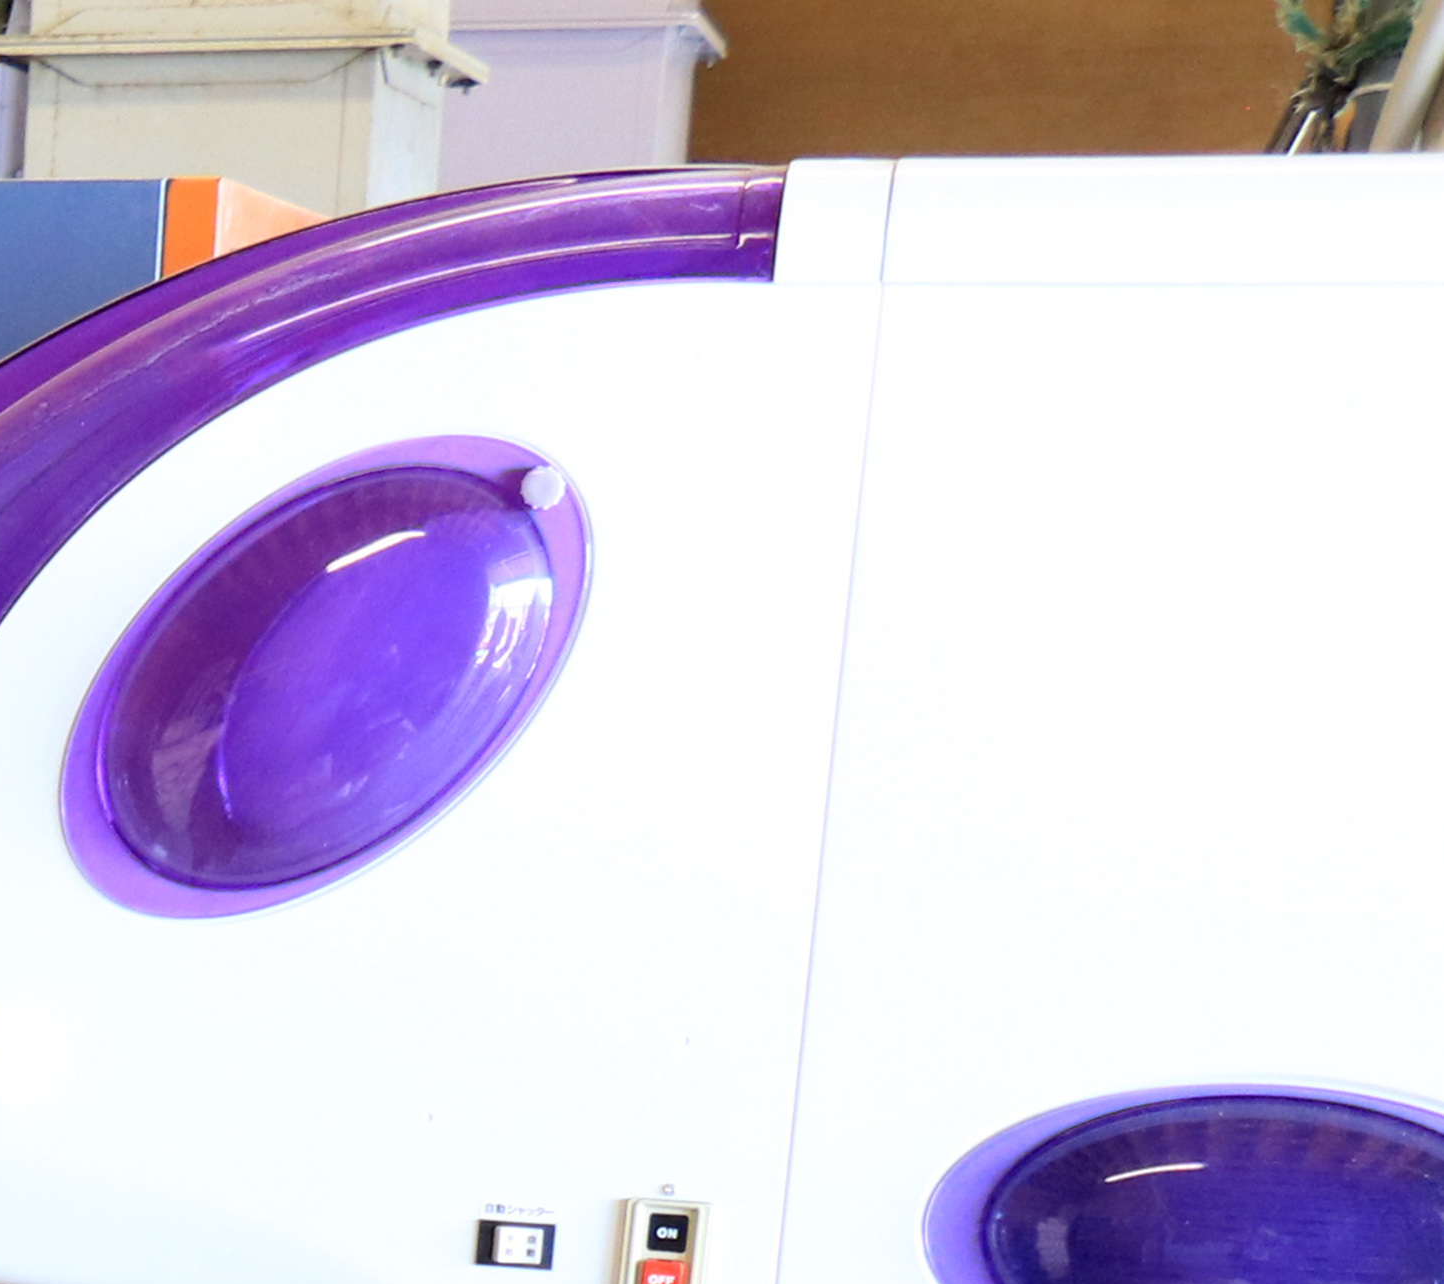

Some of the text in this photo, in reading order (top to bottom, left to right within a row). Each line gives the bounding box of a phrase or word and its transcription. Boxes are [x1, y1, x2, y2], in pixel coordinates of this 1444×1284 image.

[484, 1203, 554, 1217] 自動シャッター
[656, 1227, 678, 1239] ON
